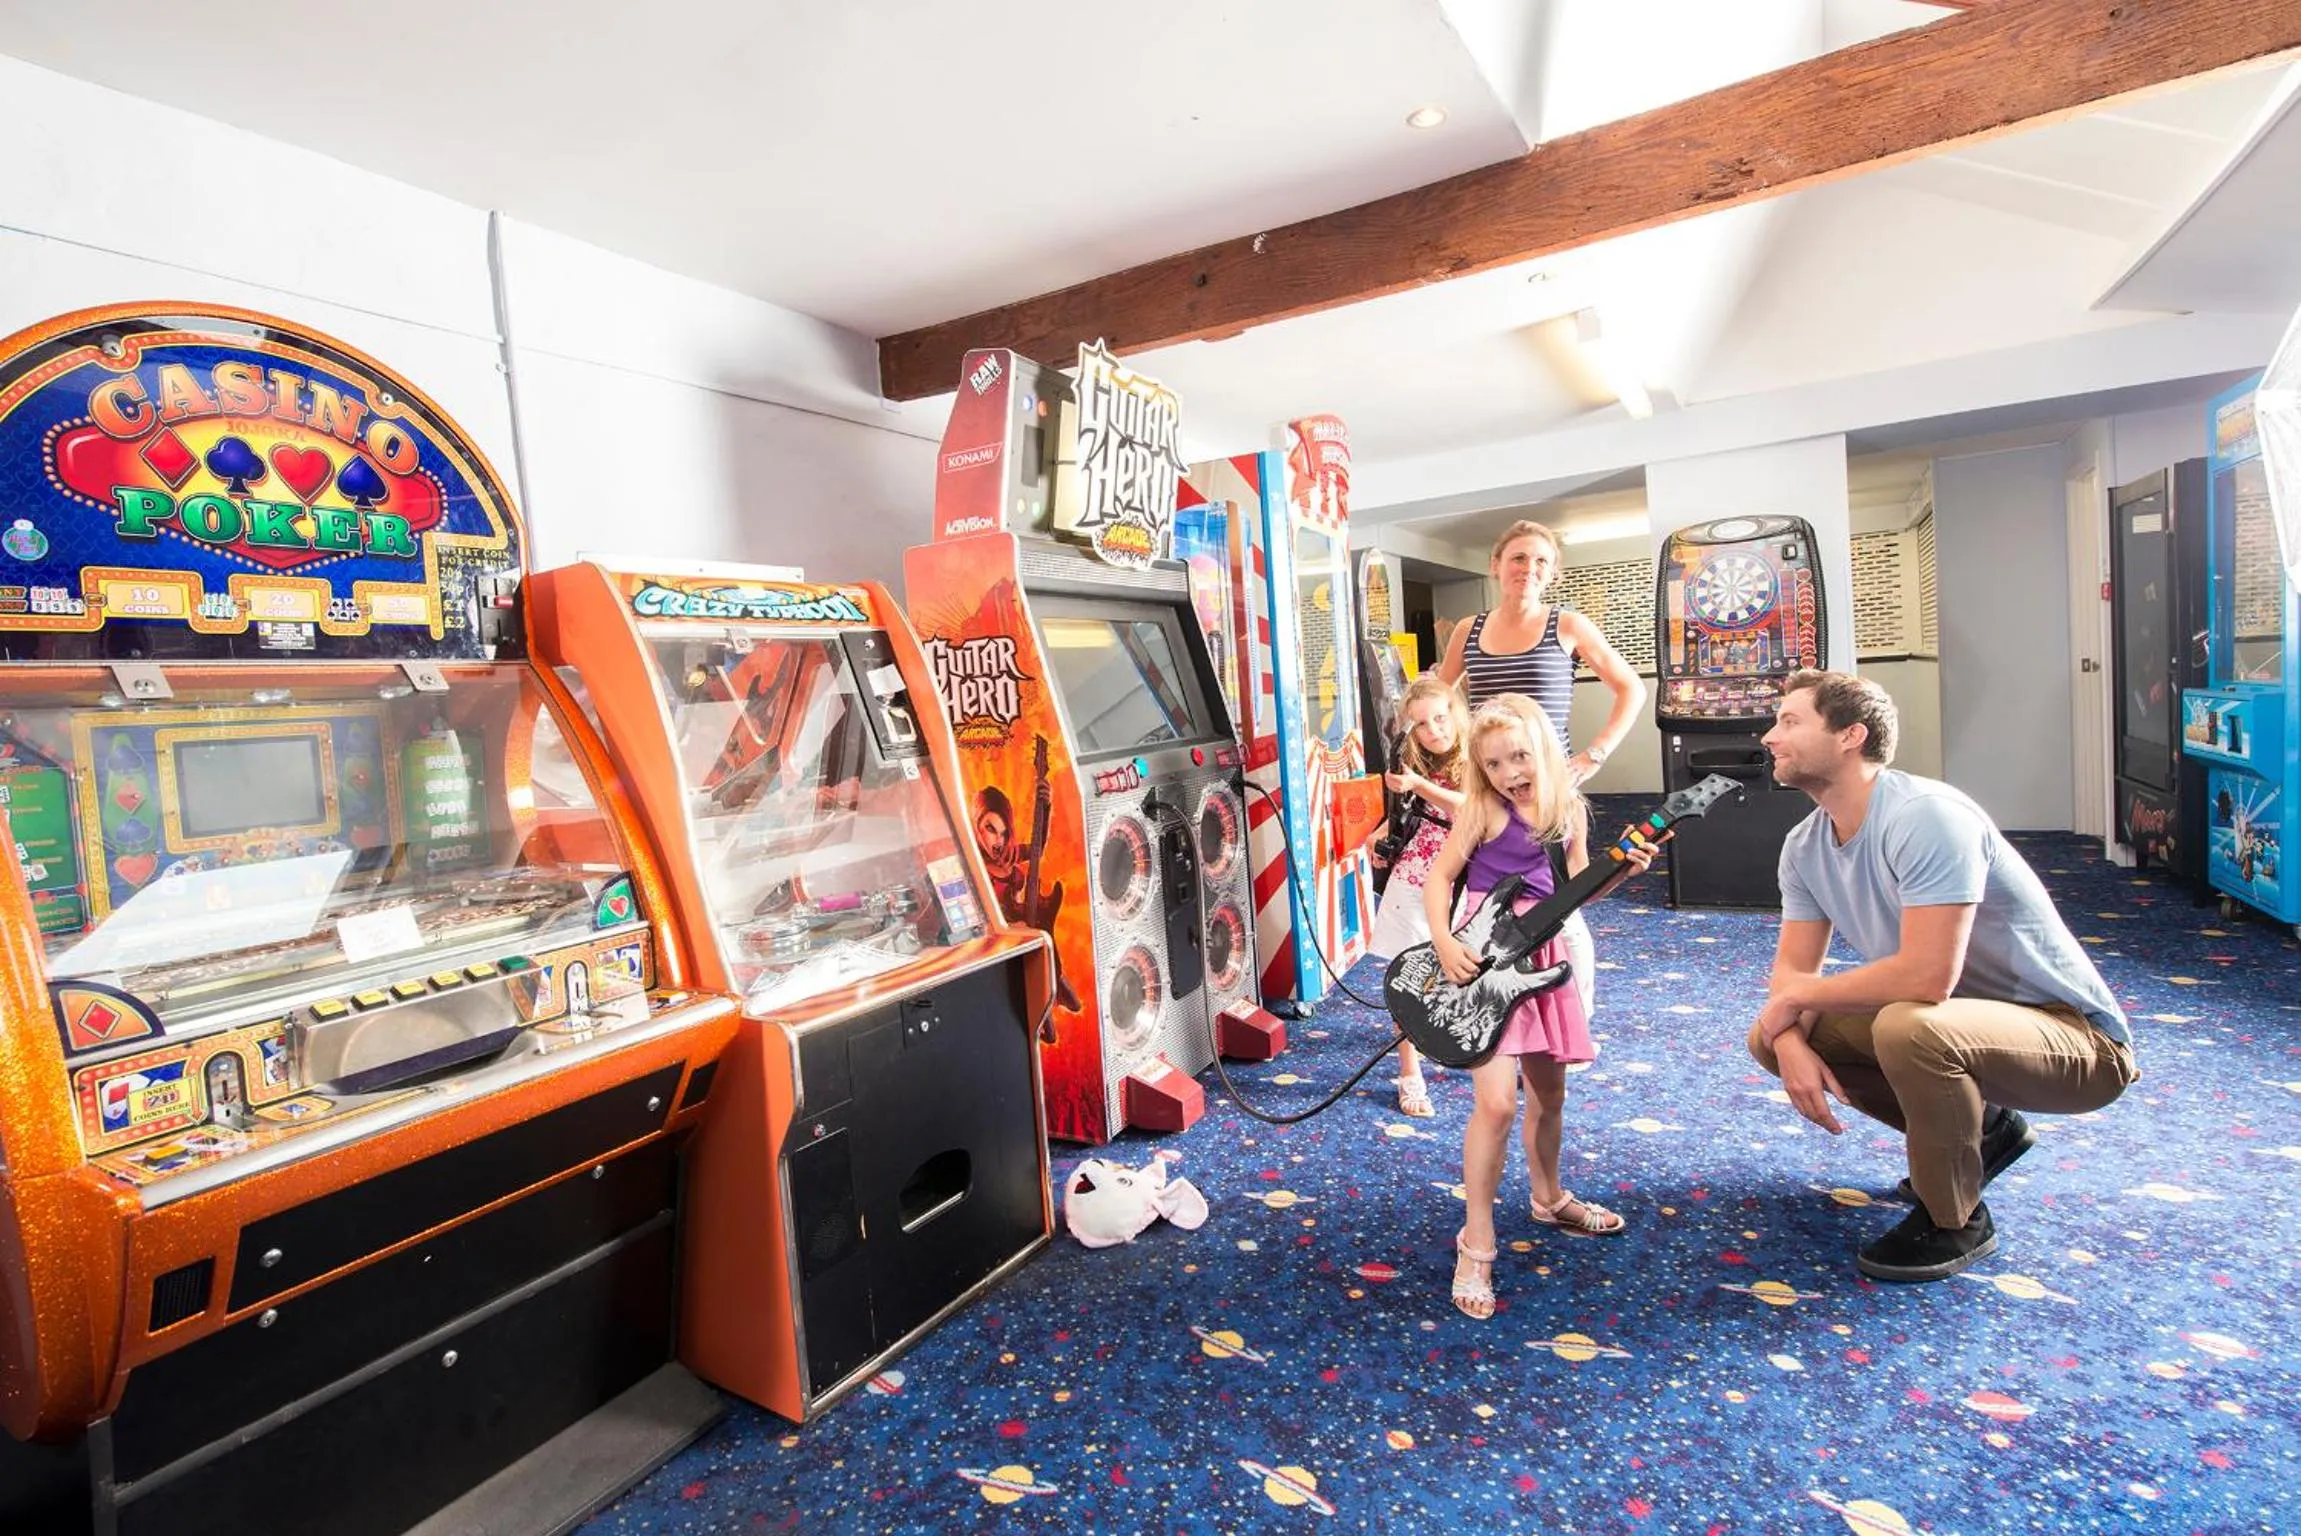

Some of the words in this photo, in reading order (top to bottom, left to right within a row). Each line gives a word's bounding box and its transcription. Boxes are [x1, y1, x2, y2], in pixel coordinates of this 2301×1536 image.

[89, 361, 419, 475] CASINO
[1078, 345, 1188, 472] GUITAR
[947, 448, 993, 468] KONAMI
[112, 486, 417, 557] POKER
[945, 516, 994, 536] ACTIVISION
[437, 546, 480, 557] INSERT
[484, 548, 511, 560] COIN
[440, 556, 463, 566] FOR
[467, 558, 509, 569] CREDIT
[131, 588, 159, 602] 10
[269, 592, 296, 606] 20
[632, 585, 743, 618] CRAZY
[746, 593, 869, 622] TYPHOON
[444, 616, 466, 629] £2
[924, 637, 1034, 692] GUITAR
[1390, 954, 1424, 993] GUITAR
